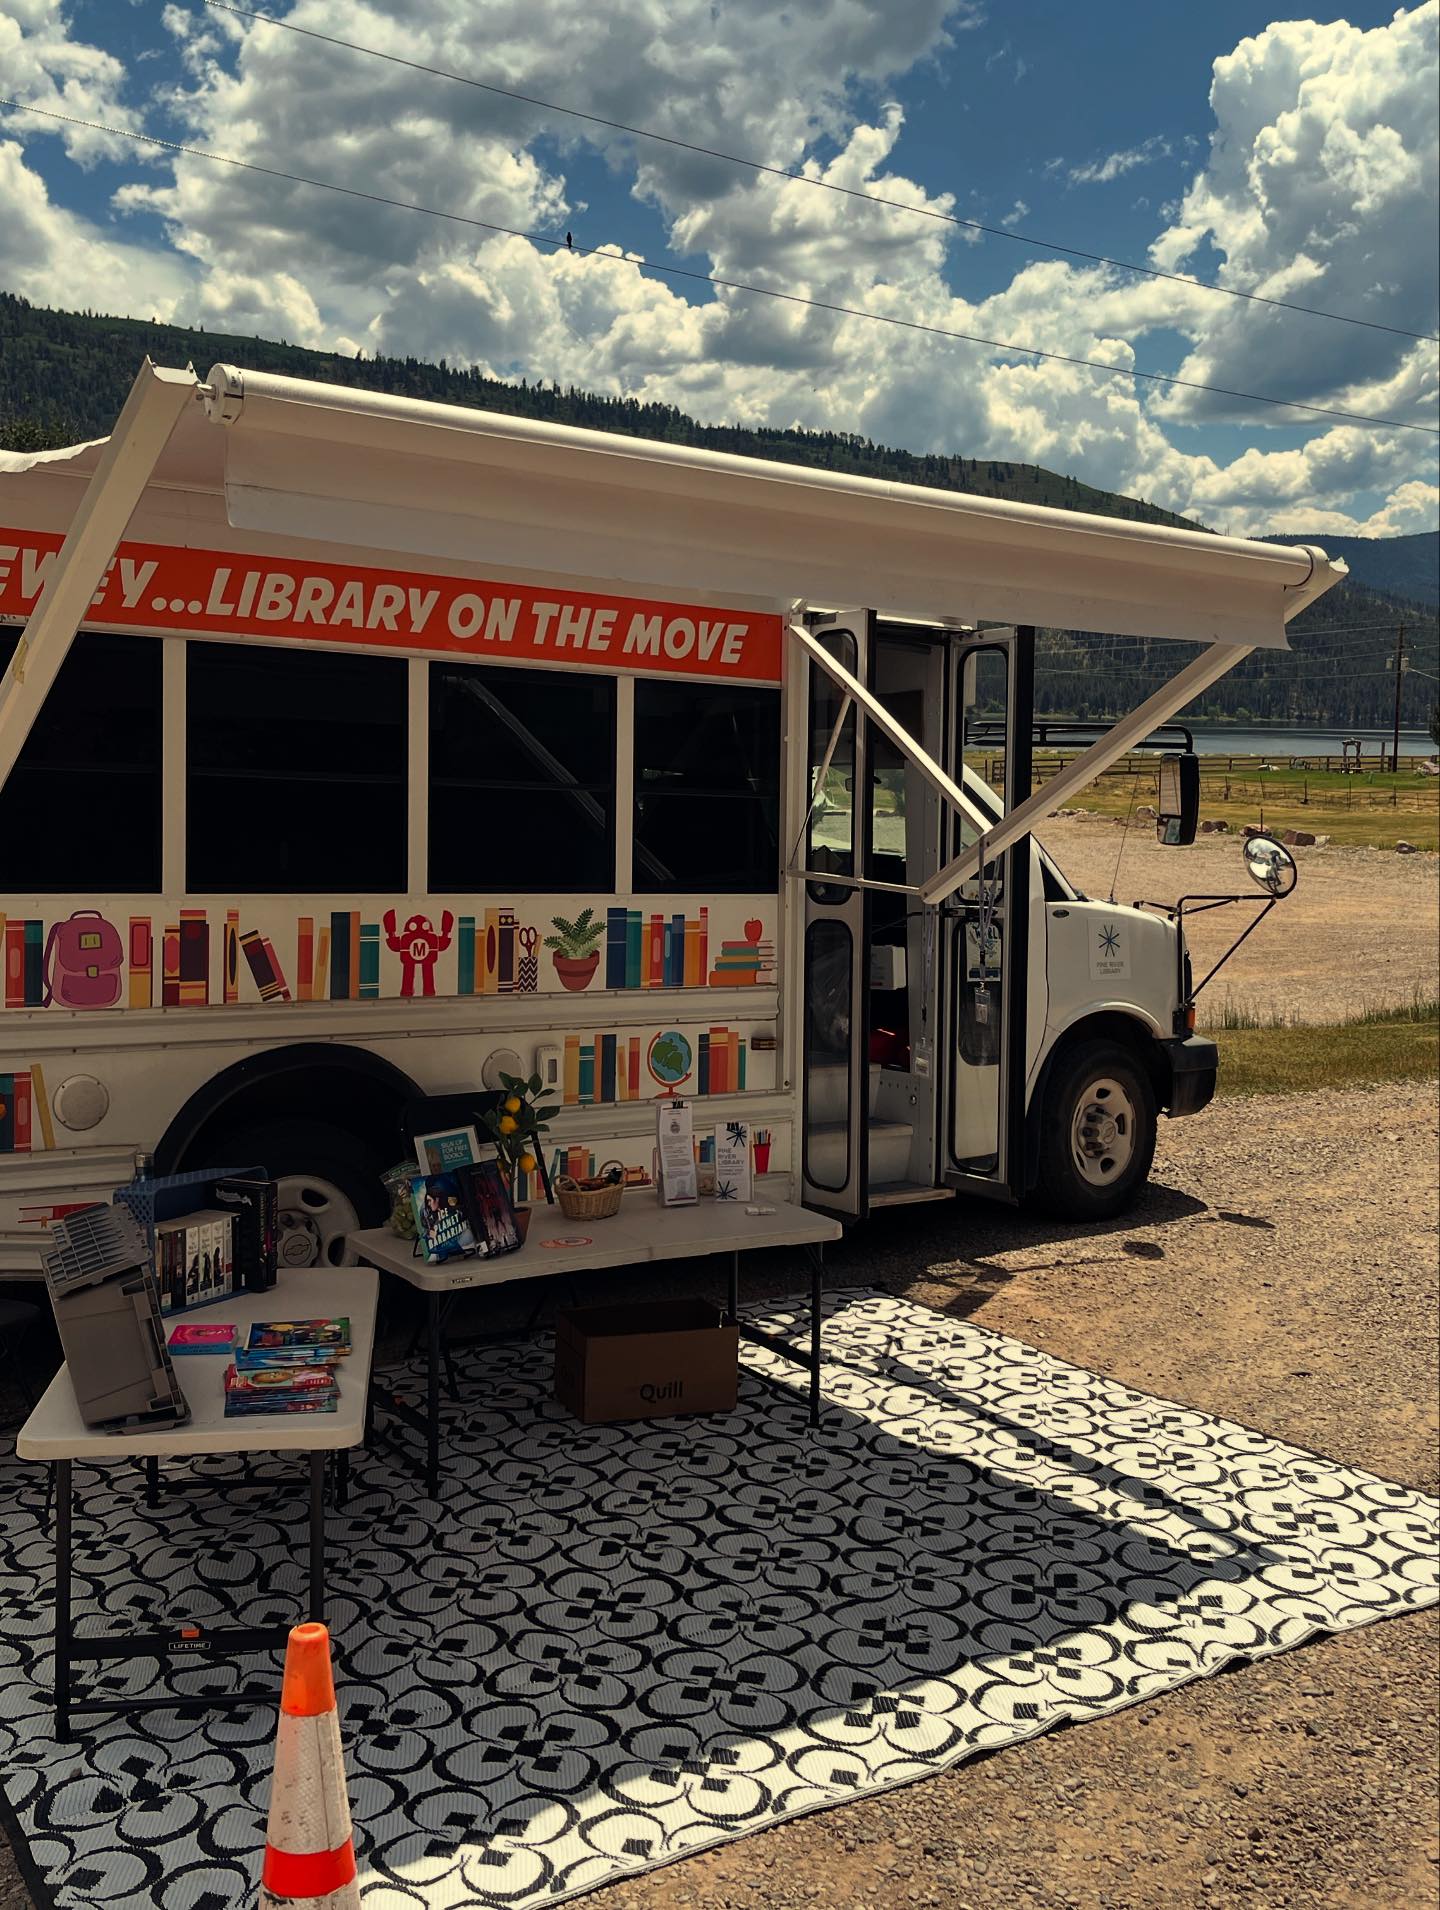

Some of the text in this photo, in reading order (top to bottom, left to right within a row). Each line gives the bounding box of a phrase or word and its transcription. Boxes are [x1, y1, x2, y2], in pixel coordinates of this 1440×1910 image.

[447, 593, 522, 642] ON
[531, 601, 619, 651] THE
[622, 613, 749, 664] MOVE
[413, 942, 425, 956] M
[434, 1213, 459, 1233] PLANET
[437, 1207, 449, 1221] ICE
[640, 1381, 683, 1404] Quill
